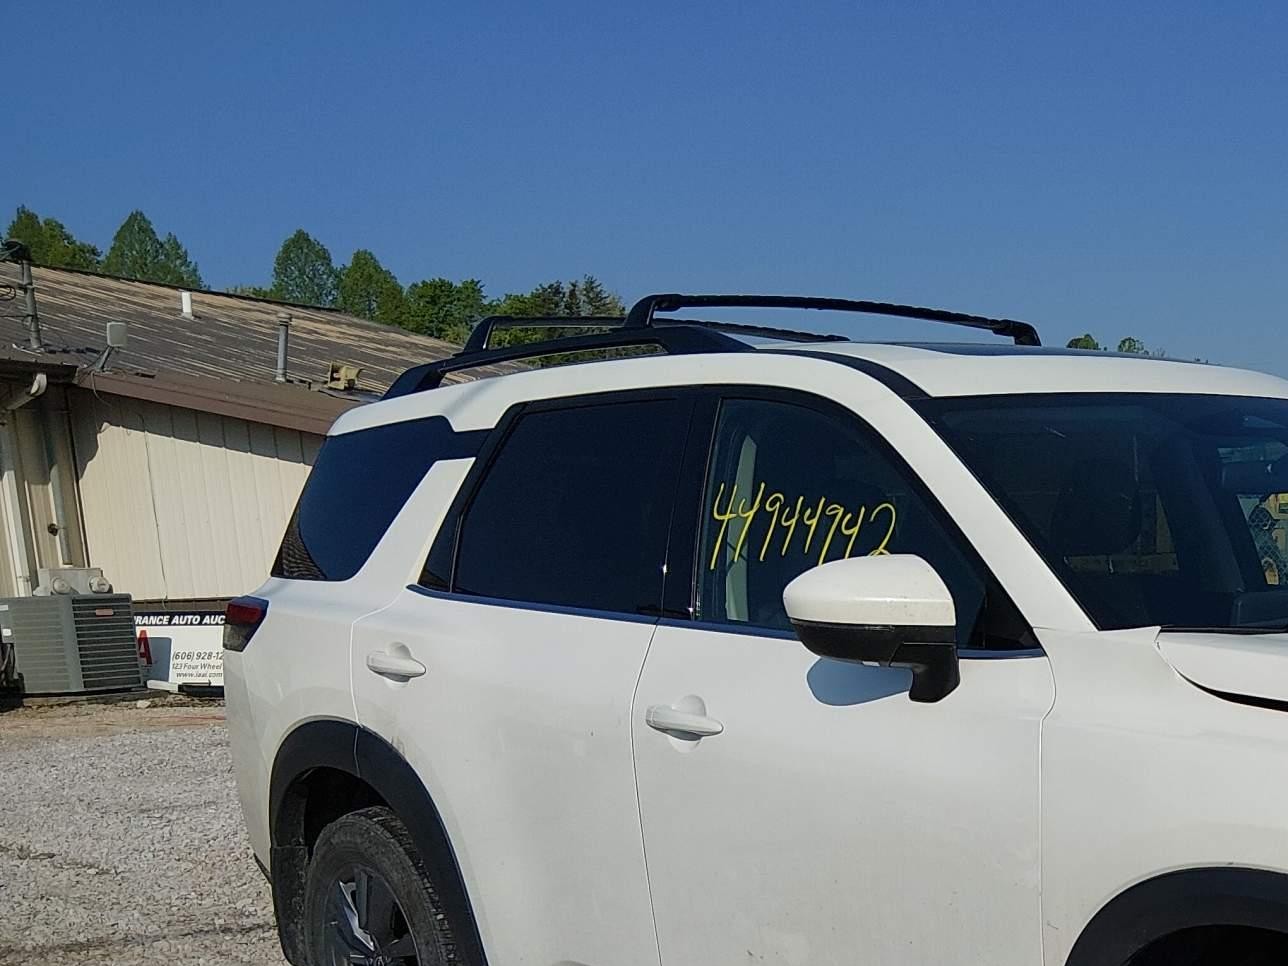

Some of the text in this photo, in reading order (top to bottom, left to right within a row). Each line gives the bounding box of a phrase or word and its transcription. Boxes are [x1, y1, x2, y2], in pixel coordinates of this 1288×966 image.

[711, 482, 896, 570] 44944942
[134, 615, 226, 624] RANCE AUTO AUC
[172, 651, 194, 661] (606)
[183, 662, 199, 670] Four
